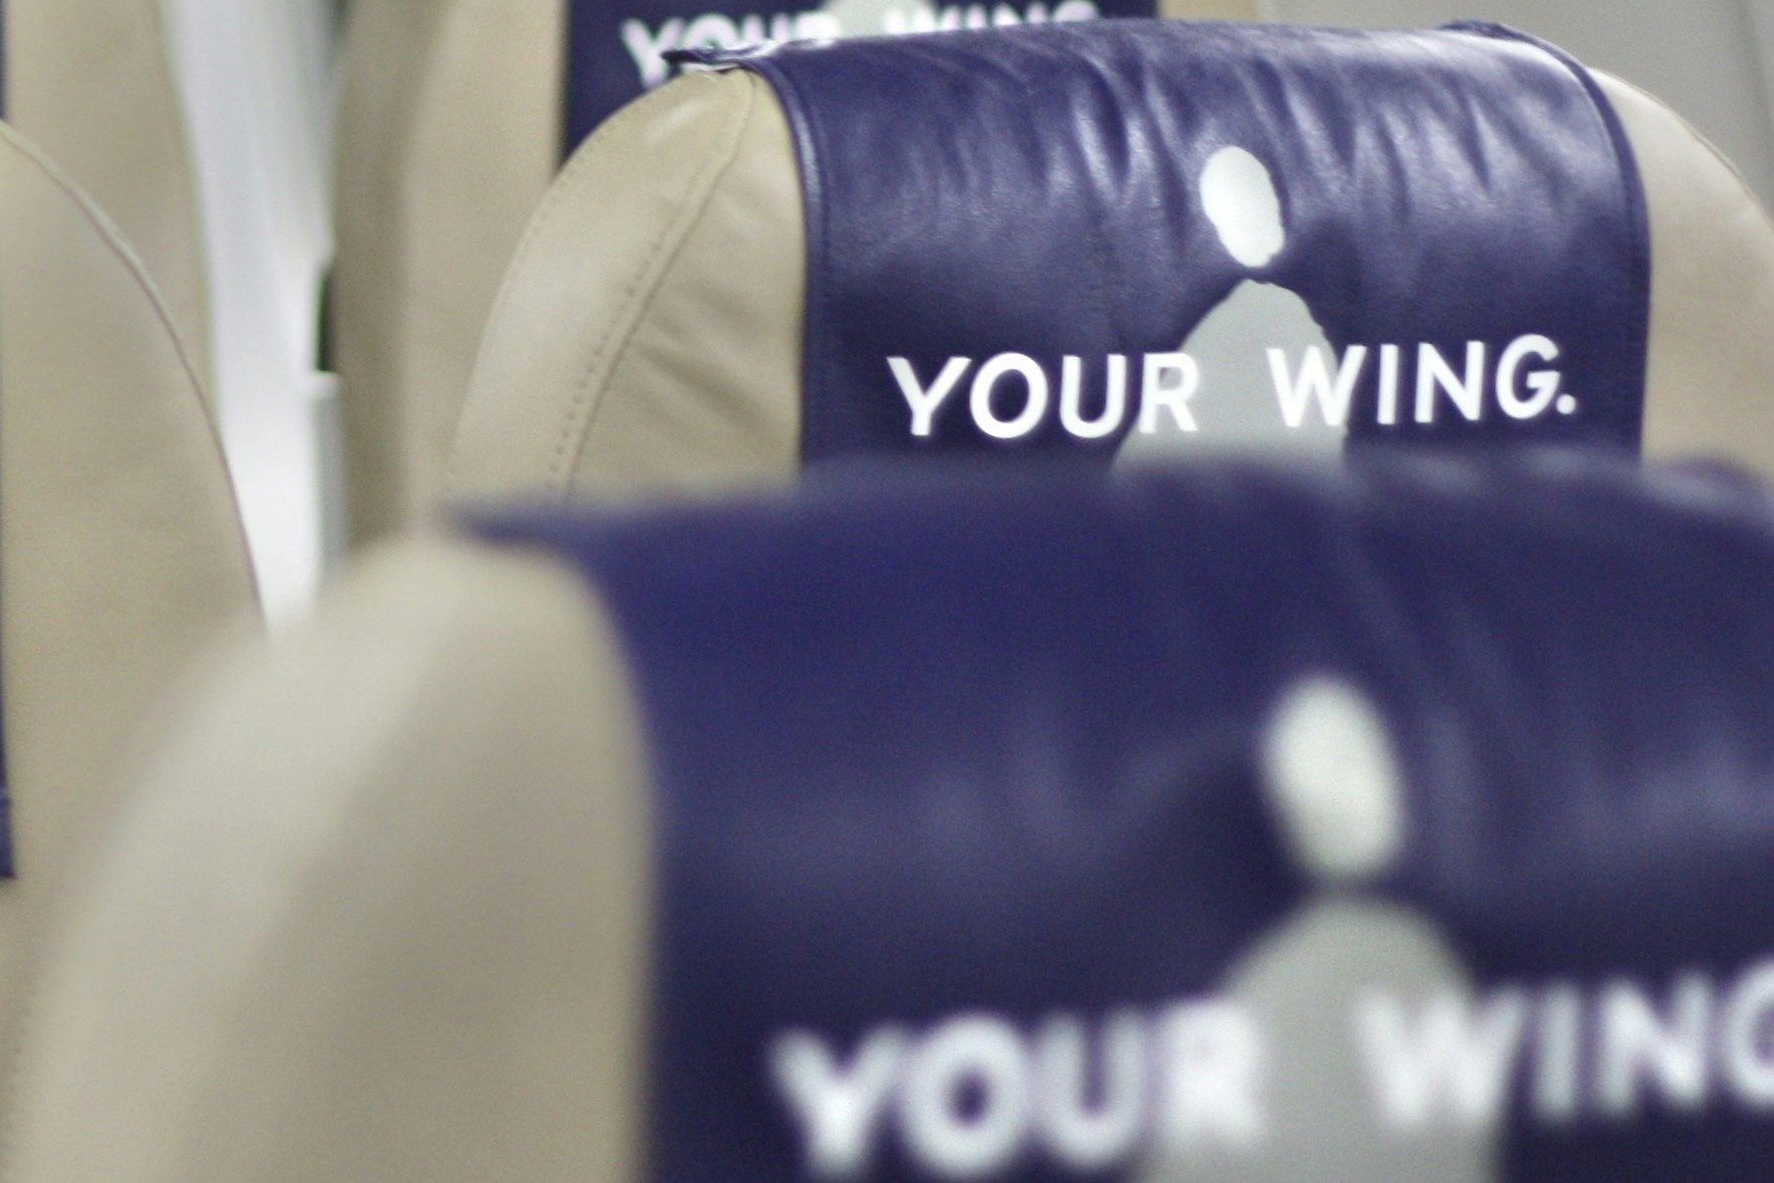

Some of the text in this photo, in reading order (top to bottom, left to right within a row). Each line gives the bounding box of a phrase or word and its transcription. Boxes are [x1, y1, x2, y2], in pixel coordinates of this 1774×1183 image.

[886, 334, 1577, 439] YOUR WING.
[773, 996, 1264, 1178] YOUR
